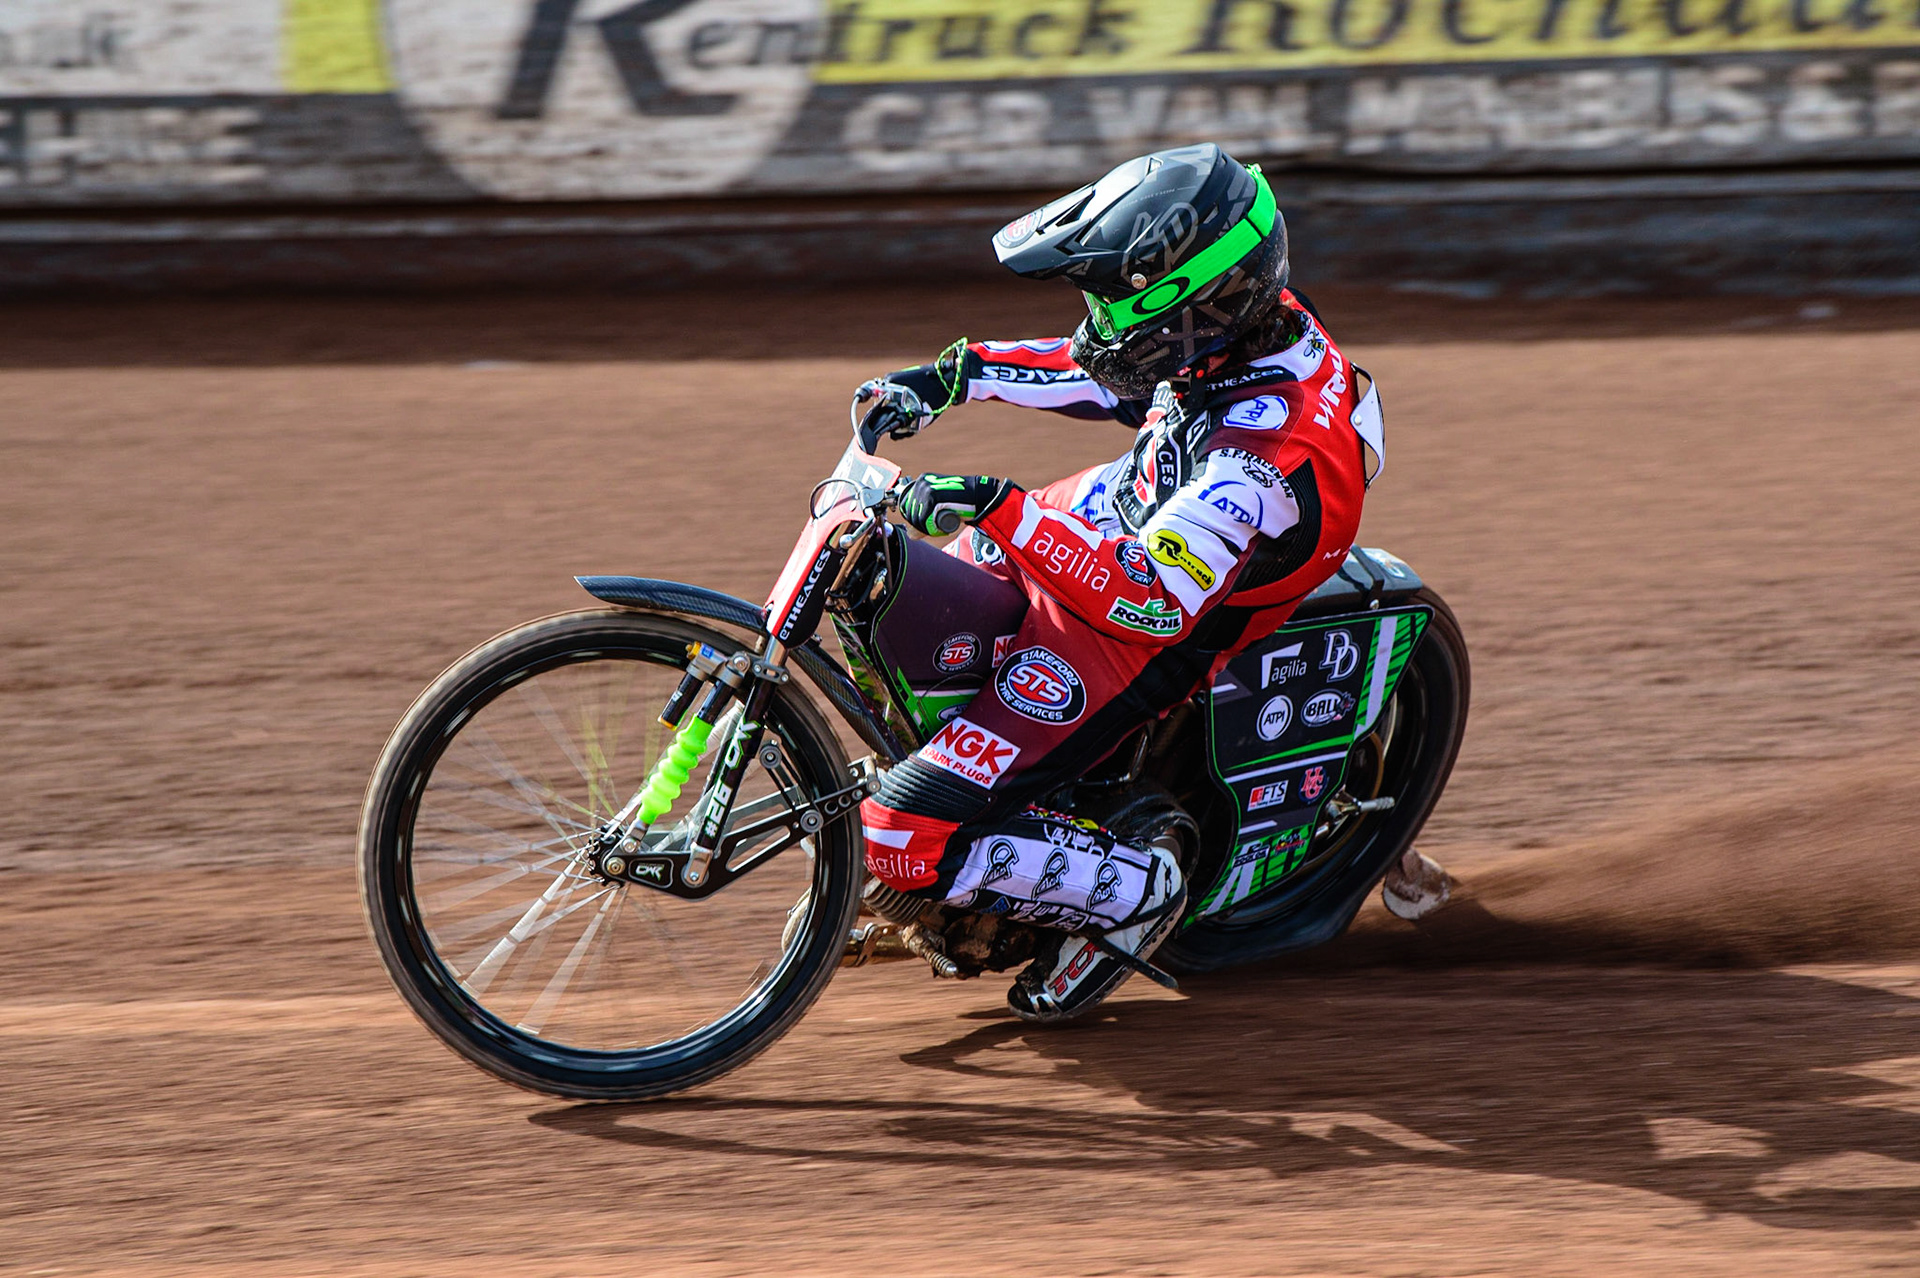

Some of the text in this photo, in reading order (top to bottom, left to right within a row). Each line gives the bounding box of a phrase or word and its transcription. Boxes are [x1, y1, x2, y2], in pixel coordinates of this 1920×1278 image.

[1034, 531, 1112, 593] agilia
[941, 645, 973, 660] STS
[1009, 666, 1069, 702] STS
[1020, 650, 1079, 687] STAKEFORD
[1271, 659, 1307, 685] agilia
[1011, 697, 1064, 721] SERVICES
[1263, 710, 1286, 726] ATPI
[932, 721, 1013, 776] NGK
[921, 748, 993, 786] SPARK PLUGS
[863, 854, 926, 879] agilia
